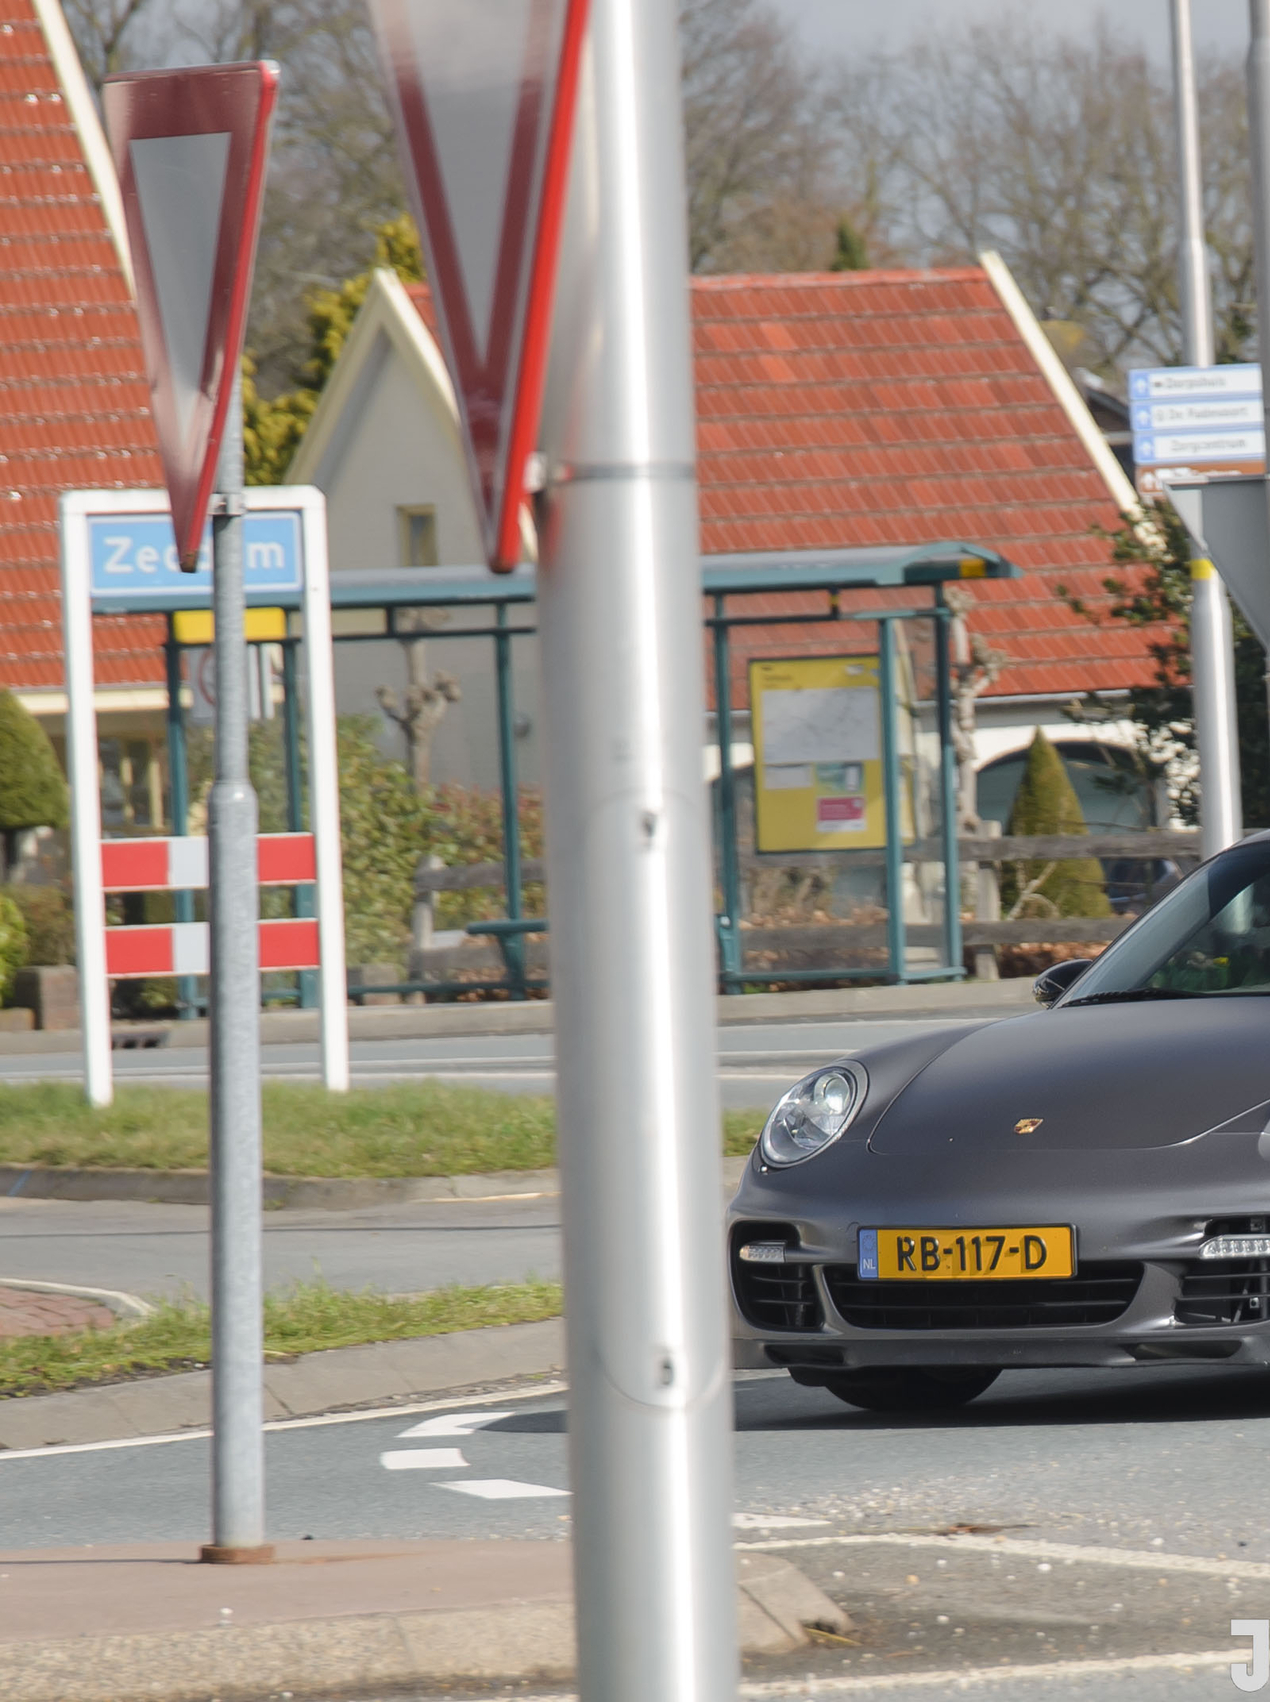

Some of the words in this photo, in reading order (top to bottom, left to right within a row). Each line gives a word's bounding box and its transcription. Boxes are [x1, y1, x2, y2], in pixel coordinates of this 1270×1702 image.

[104, 536, 285, 574] Zedm
[862, 1258, 876, 1270] NL
[896, 1234, 1048, 1272] RB-117-D
